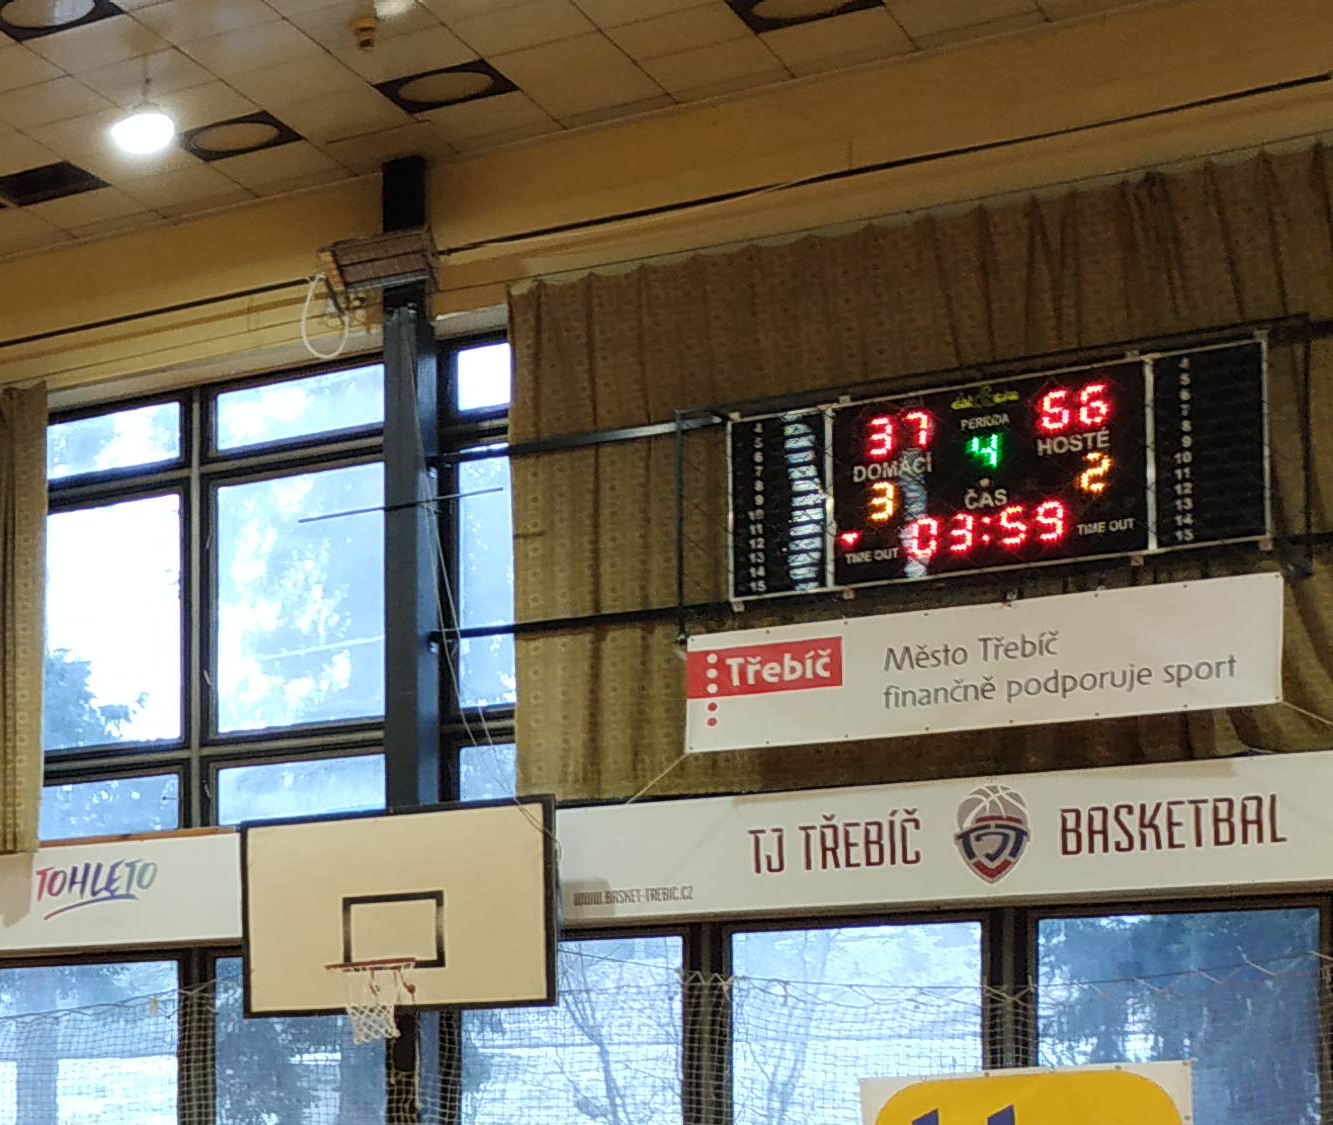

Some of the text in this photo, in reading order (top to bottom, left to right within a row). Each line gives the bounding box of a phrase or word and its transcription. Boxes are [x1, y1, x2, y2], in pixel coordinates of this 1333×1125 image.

[1179, 373, 1191, 385] 5
[1041, 384, 1108, 430] 56
[960, 413, 1010, 431] PERIODA
[1181, 419, 1192, 432] 8
[868, 411, 930, 456] 37
[1037, 427, 1110, 456] HOSTÉ
[1181, 435, 1192, 448] 9
[753, 451, 764, 463] 6
[970, 433, 999, 469] 4
[1174, 451, 1193, 464] 10
[852, 453, 933, 483] DOMÁCÍ
[1080, 451, 1112, 493] 2
[1174, 467, 1191, 480] 11
[754, 480, 764, 492] 8
[1174, 482, 1193, 495] 12
[754, 494, 764, 506] 9
[869, 481, 894, 522] 3
[964, 488, 1008, 509] ČAS
[1174, 497, 1193, 510] 13
[1076, 517, 1135, 536] TIME OUT
[1174, 513, 1194, 526] 14
[749, 524, 763, 535] 11
[909, 500, 1066, 558] 03:59
[1174, 528, 1195, 541] 15
[749, 538, 765, 550] 12
[749, 552, 765, 564] 13
[845, 547, 900, 565] TIME OUT
[749, 566, 765, 578] 14
[749, 580, 766, 592] 15
[883, 631, 1060, 672] Město Třebíč
[725, 649, 831, 687] Třebíč
[883, 654, 1237, 709] finančně podporuje sport
[748, 793, 1288, 875] TJ TŘEBÍČ BASKETBAL
[36, 858, 158, 903] TOHLETO
